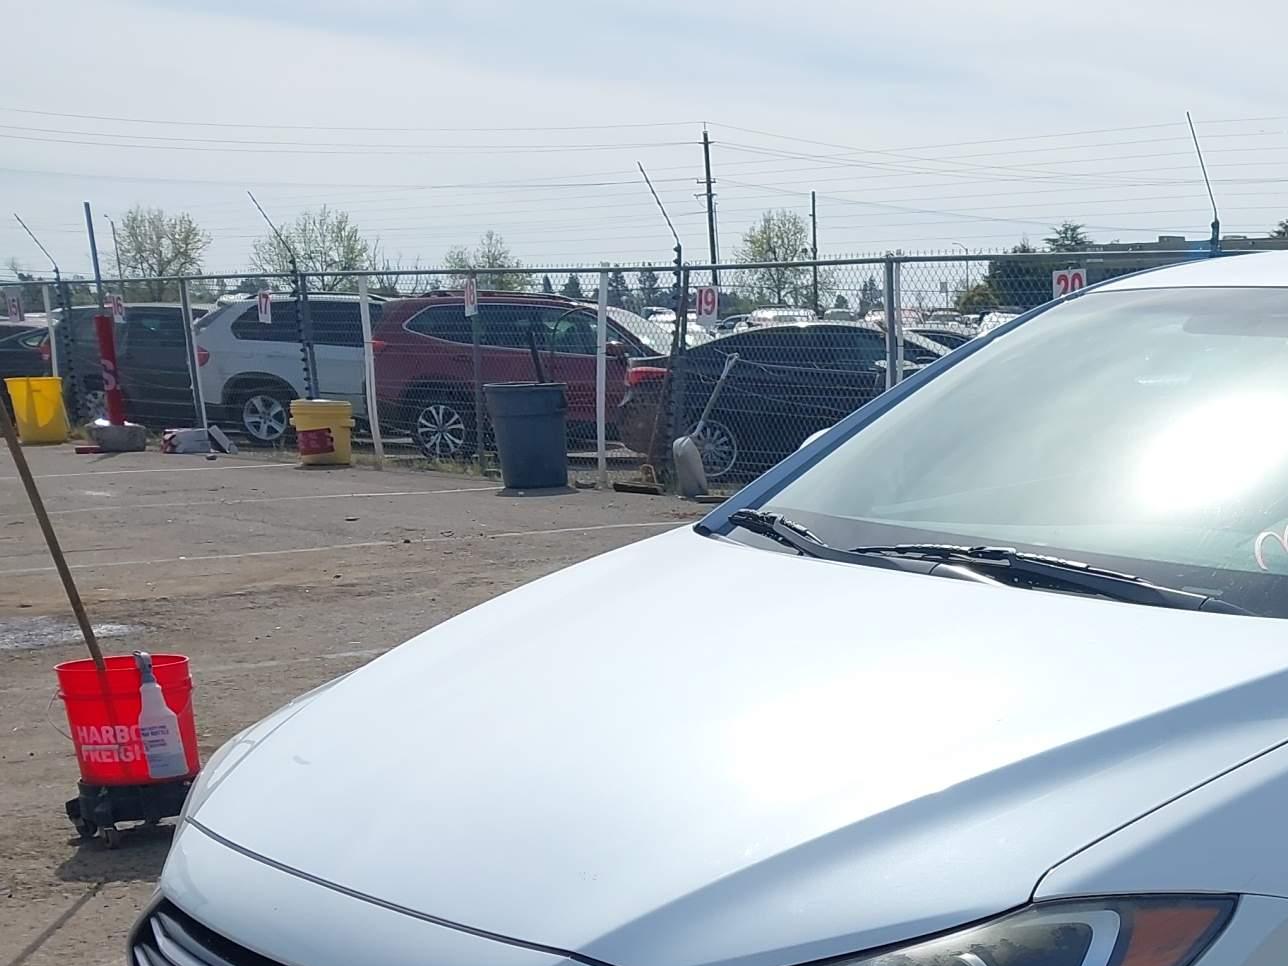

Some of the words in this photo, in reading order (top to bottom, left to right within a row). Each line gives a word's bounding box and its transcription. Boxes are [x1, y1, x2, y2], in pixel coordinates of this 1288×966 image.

[1056, 272, 1083, 297] 20
[698, 287, 716, 316] 19
[76, 725, 141, 744] HARBO
[81, 743, 144, 763] FREIGH
